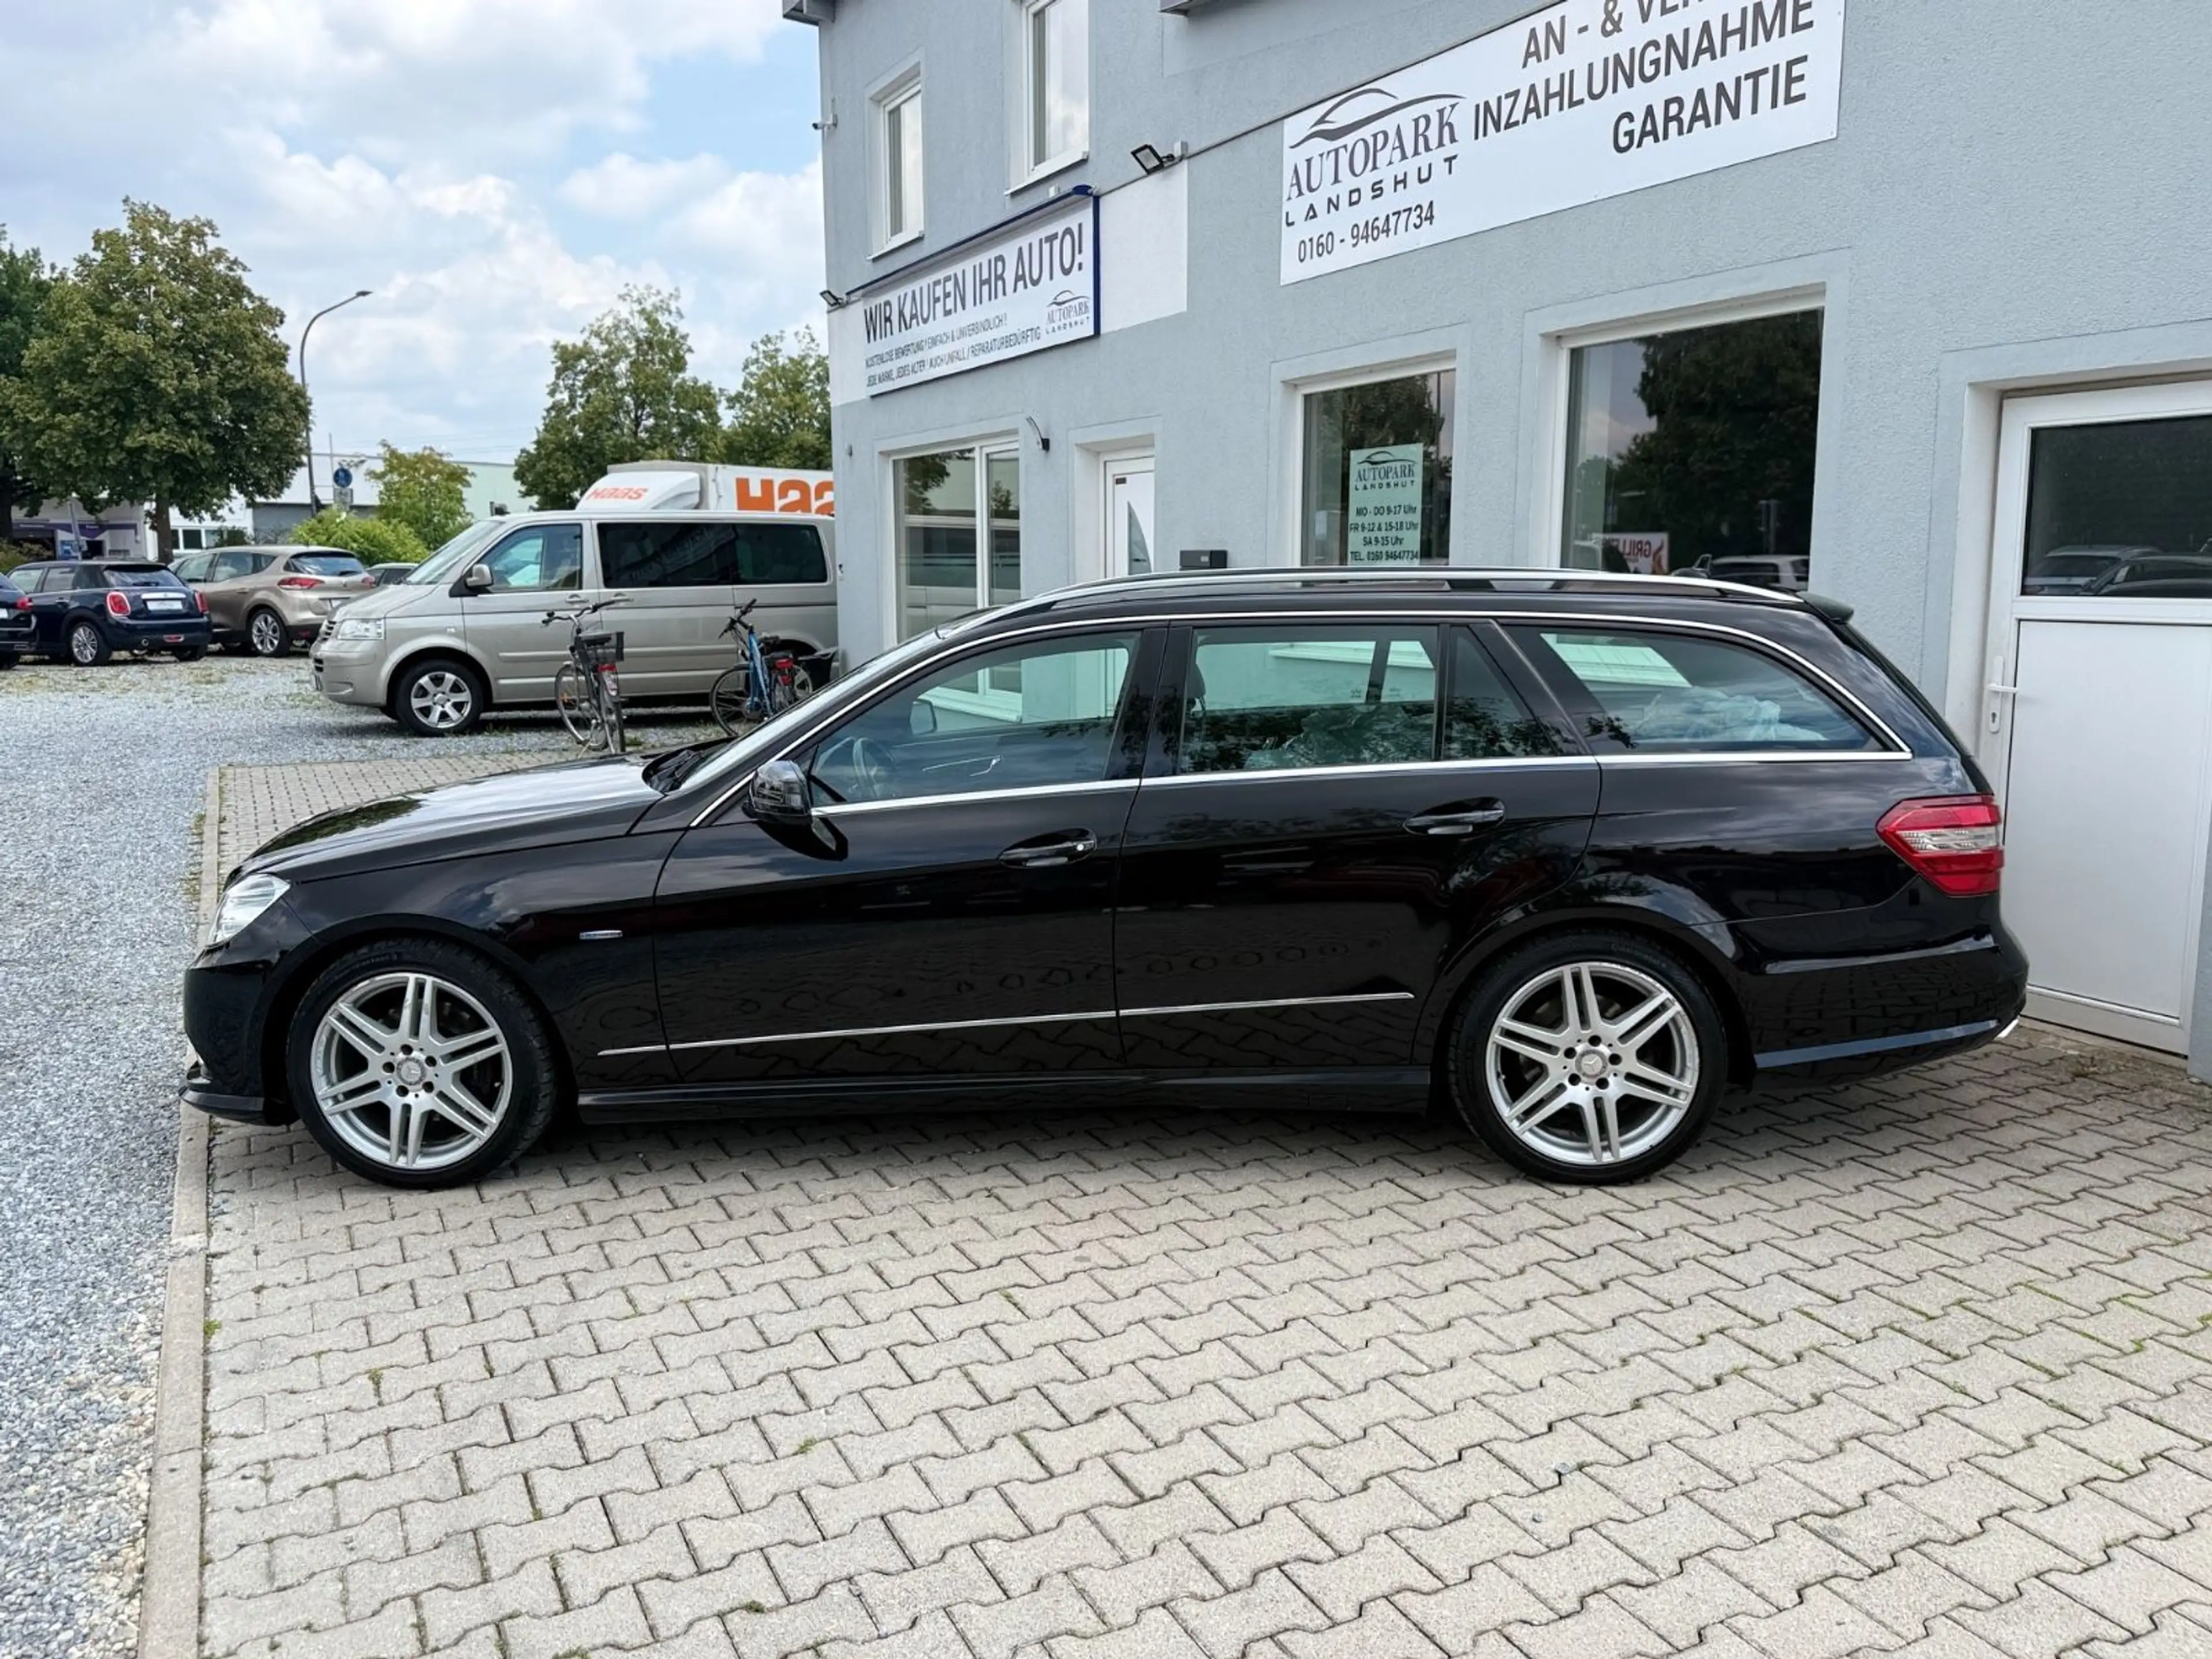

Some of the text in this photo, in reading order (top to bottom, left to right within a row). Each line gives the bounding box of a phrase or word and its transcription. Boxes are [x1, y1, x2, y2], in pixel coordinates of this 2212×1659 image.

[1474, 0, 1815, 141] INZAHLUNGNAHME
[1613, 55, 1808, 154] GARANTIE
[1286, 101, 1460, 202] AUTOPARK
[1285, 154, 1459, 227] LANDSHUT
[1298, 231, 1334, 263] 0160
[1351, 200, 1435, 248] 94647734
[864, 222, 1083, 343] WIR KAUFEN IHR AUTO!
[1046, 300, 1090, 325] AUTOPARK
[1045, 316, 1090, 335] LANDSHUT
[1354, 479, 1415, 491] LANDSHUT
[1355, 463, 1415, 482] AUTOPARK
[1391, 534, 1404, 546] Uhr
